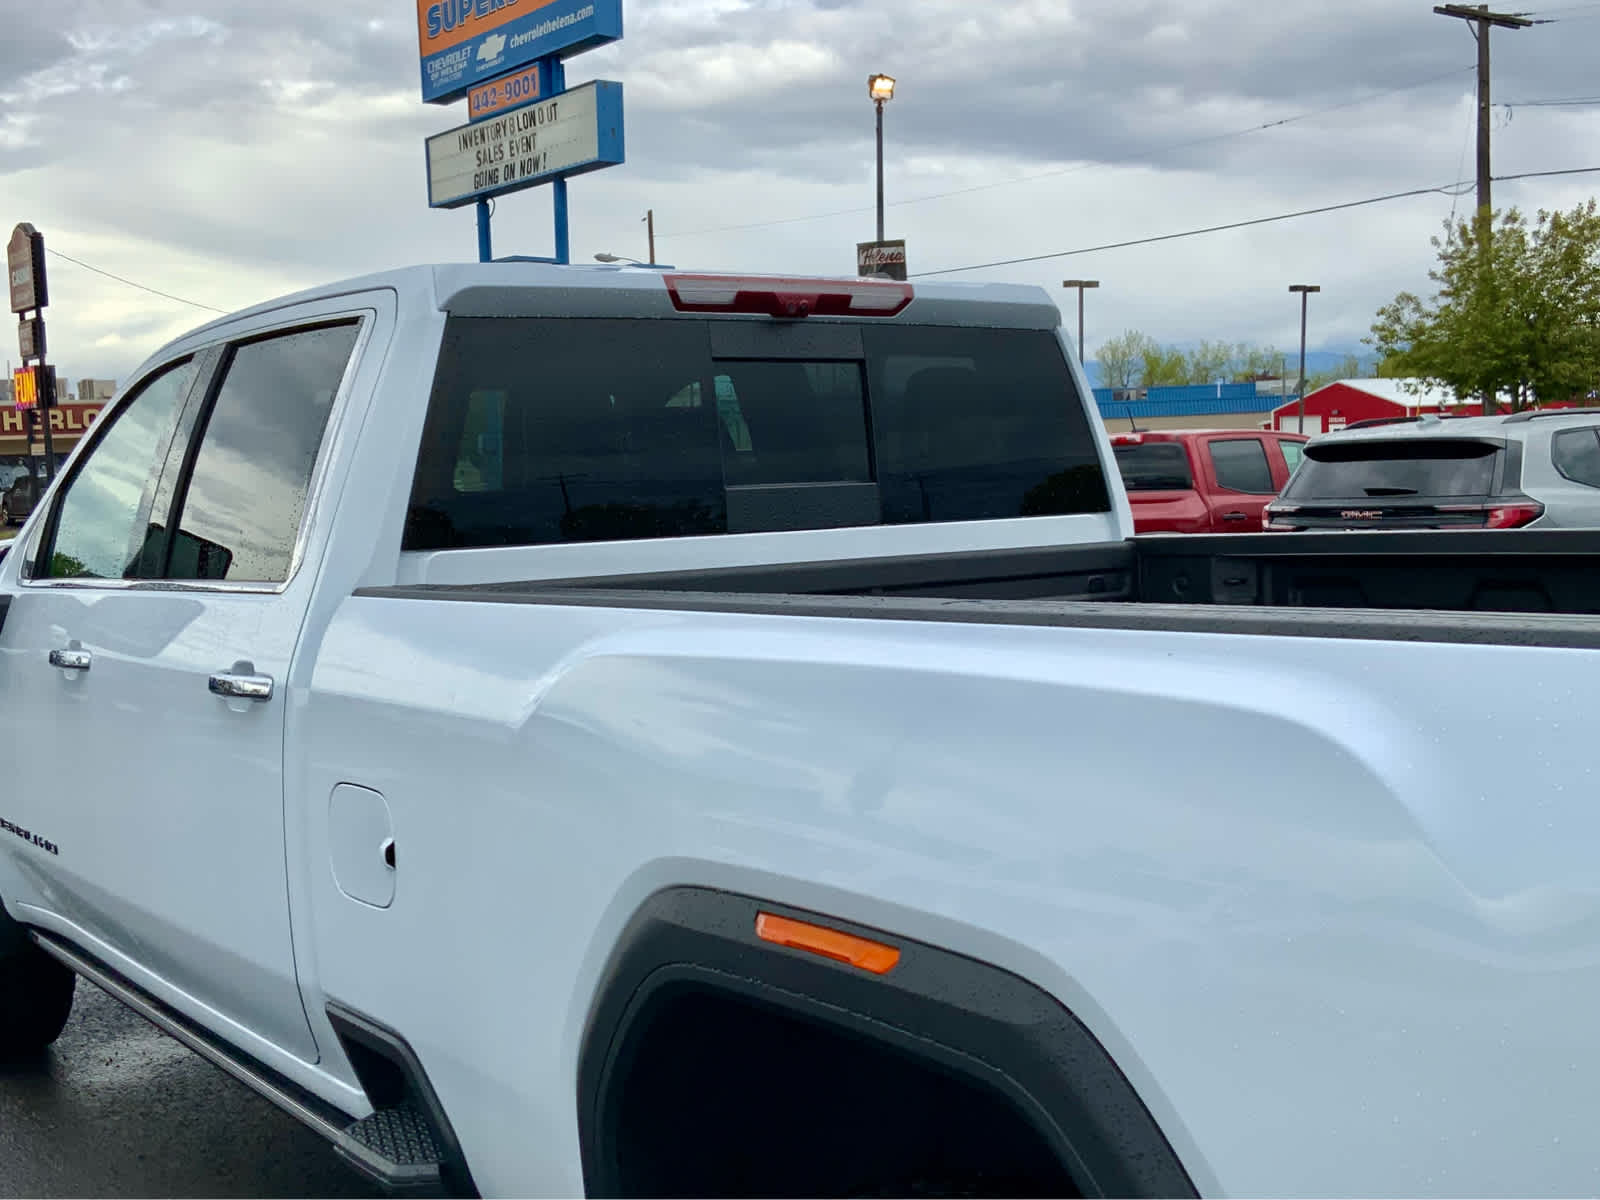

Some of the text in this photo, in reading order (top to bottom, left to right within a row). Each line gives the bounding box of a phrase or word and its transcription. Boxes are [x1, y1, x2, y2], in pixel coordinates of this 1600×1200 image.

[510, 5, 594, 48] chevrolethelena.com
[473, 72, 537, 111] 442-9001
[458, 120, 507, 152] INVENTORY
[475, 133, 537, 168] SALES EVENT
[473, 167, 500, 190] GOING
[503, 162, 516, 181] ON
[1340, 510, 1383, 520] GMC
